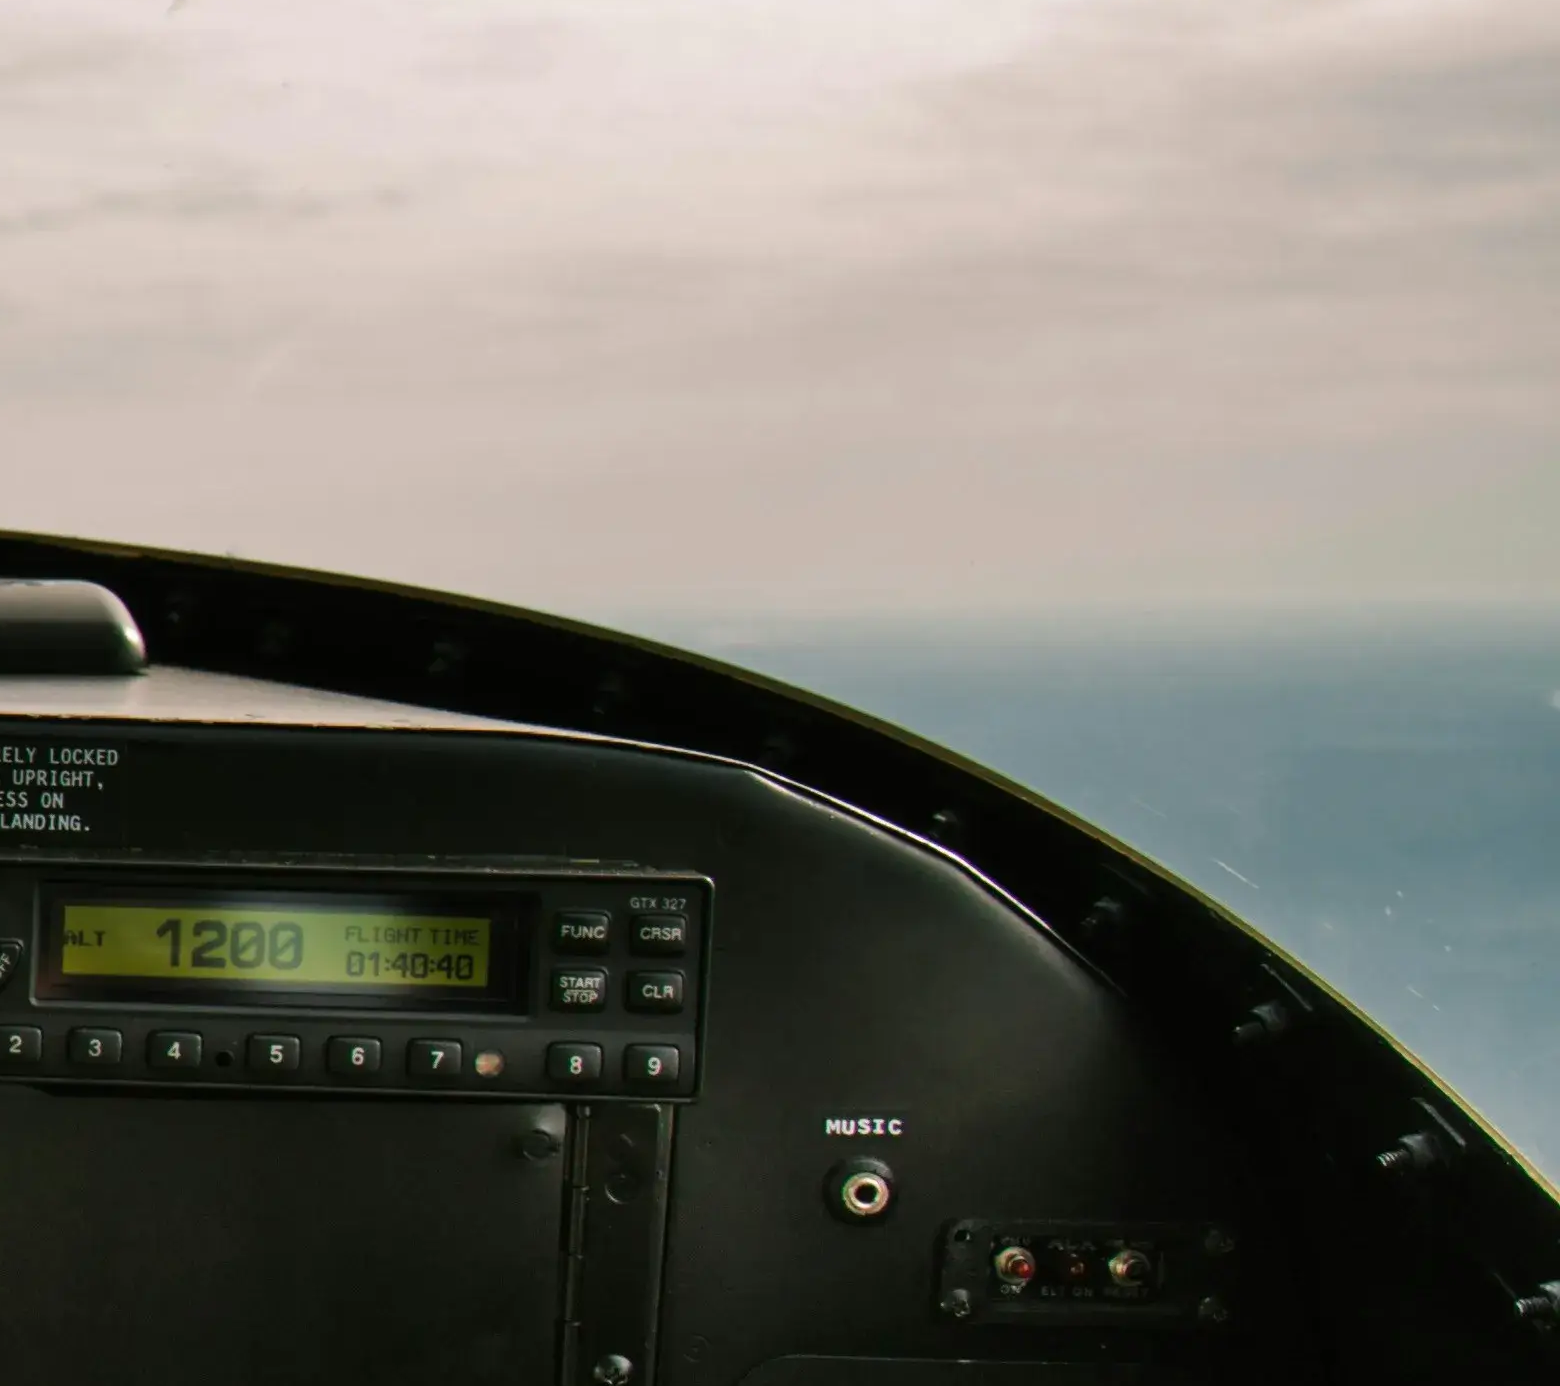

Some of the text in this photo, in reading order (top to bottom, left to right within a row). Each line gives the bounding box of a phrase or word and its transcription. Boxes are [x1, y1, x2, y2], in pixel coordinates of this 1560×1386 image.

[49, 746, 118, 764] LOCKED
[12, 768, 105, 790] UPRIGHT,
[40, 791, 63, 807] ON
[630, 898, 687, 911] GTX 327
[345, 927, 480, 947] FLIGHT TIME
[560, 923, 606, 941] FUNC
[639, 924, 683, 943] CRSR
[157, 919, 302, 970] 1200
[345, 952, 474, 980] 01:40:40
[641, 982, 674, 1001] CLR
[89, 1040, 102, 1057] 3
[351, 1048, 364, 1065] 6
[569, 1055, 583, 1075] 8
[648, 1056, 661, 1077] 9
[826, 1118, 902, 1136] MUSIC
